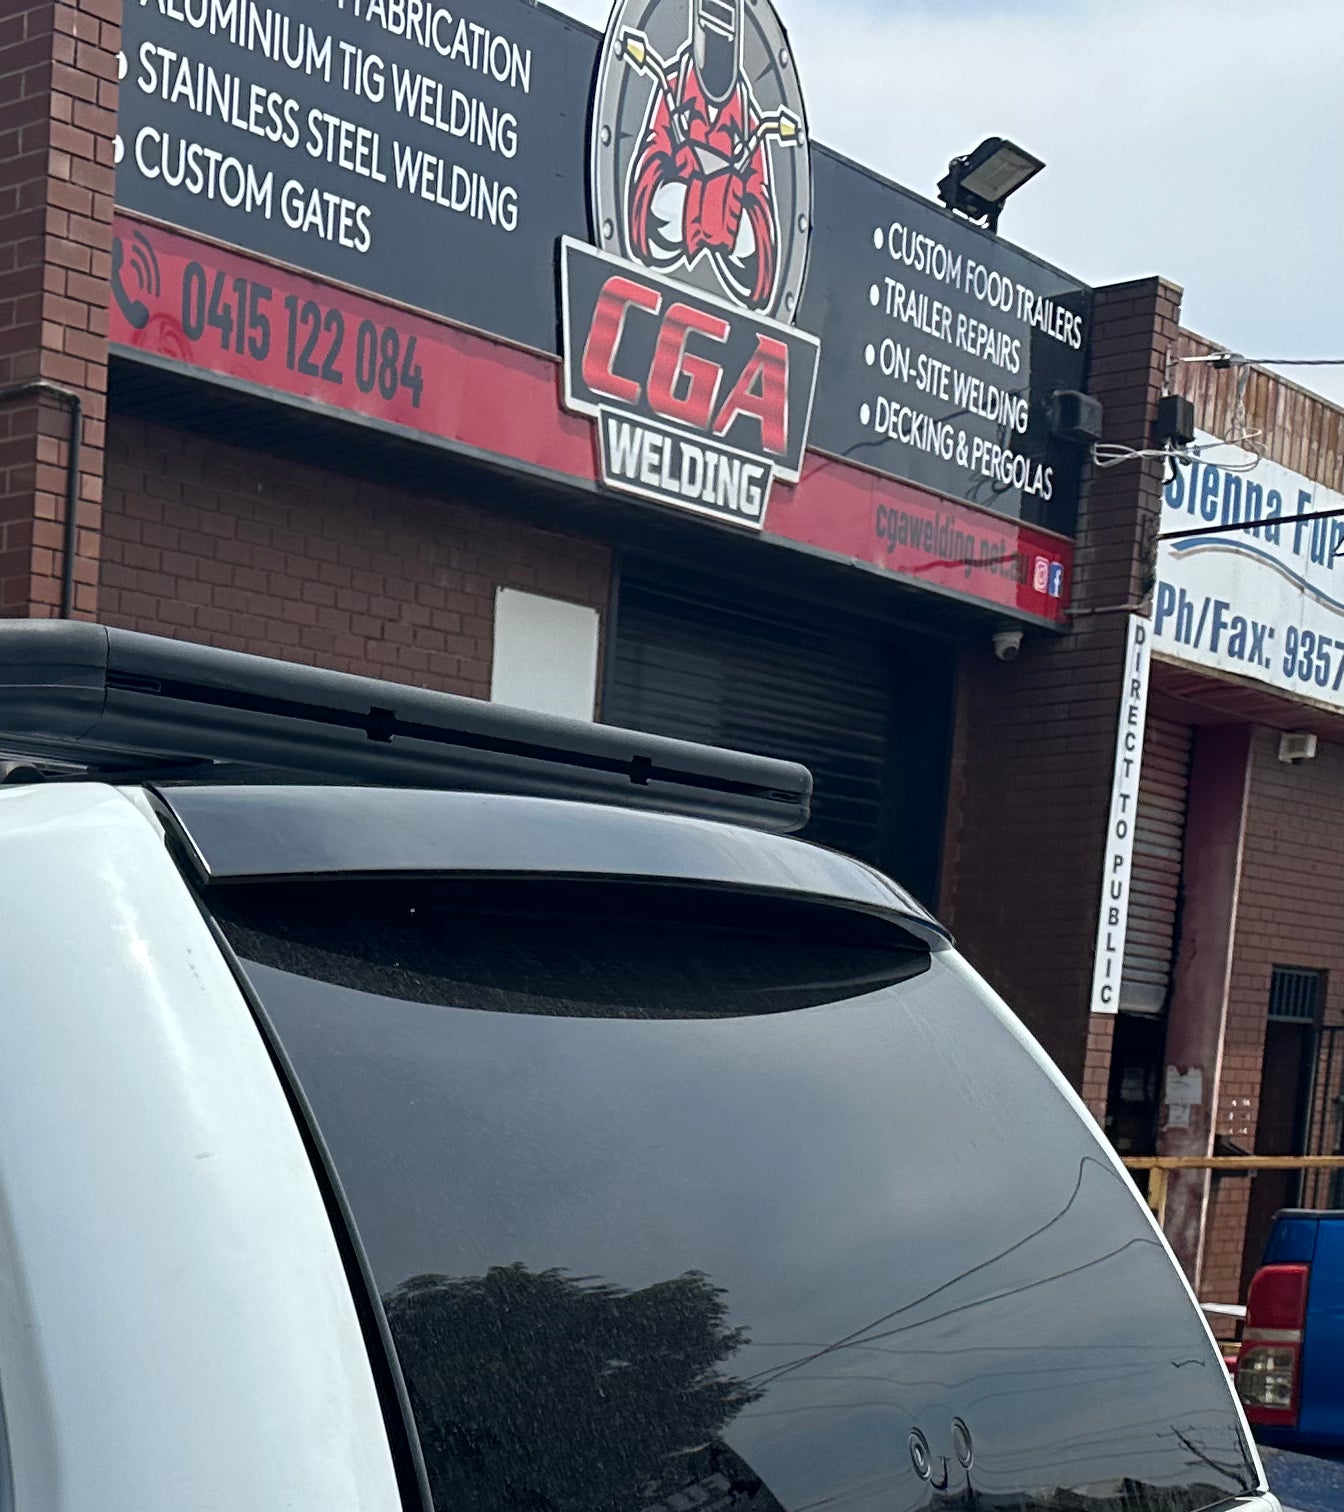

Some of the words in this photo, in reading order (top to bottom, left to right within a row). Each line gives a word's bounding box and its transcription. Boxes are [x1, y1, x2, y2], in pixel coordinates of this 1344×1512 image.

[137, 41, 300, 148] STAINLESS
[306, 109, 387, 182] STEEL
[394, 141, 519, 232] WELDING
[339, 41, 385, 102] TIG
[392, 63, 518, 158] WELDING
[135, 126, 274, 219] CUSTOM
[281, 180, 372, 253] GATES
[182, 260, 272, 361] 0415
[283, 294, 344, 385] 122
[355, 319, 423, 408] 084
[884, 277, 952, 343] TRAILER
[955, 317, 1021, 374] REPAIRS
[888, 222, 963, 290] CUSTOM
[965, 260, 1013, 313] FOOD
[1016, 284, 1082, 350] TRAILERS
[581, 275, 788, 457] CGA
[879, 338, 950, 401] ON-SITE
[953, 373, 1028, 434] WELDING
[607, 417, 764, 517] WELDING
[874, 396, 954, 461] DECKING
[955, 434, 970, 468] &
[971, 436, 1053, 501] PERGOLAS
[1122, 624, 1146, 780] DIRECT
[1115, 793, 1131, 840] TO
[1101, 854, 1125, 1005] PUBLIC
